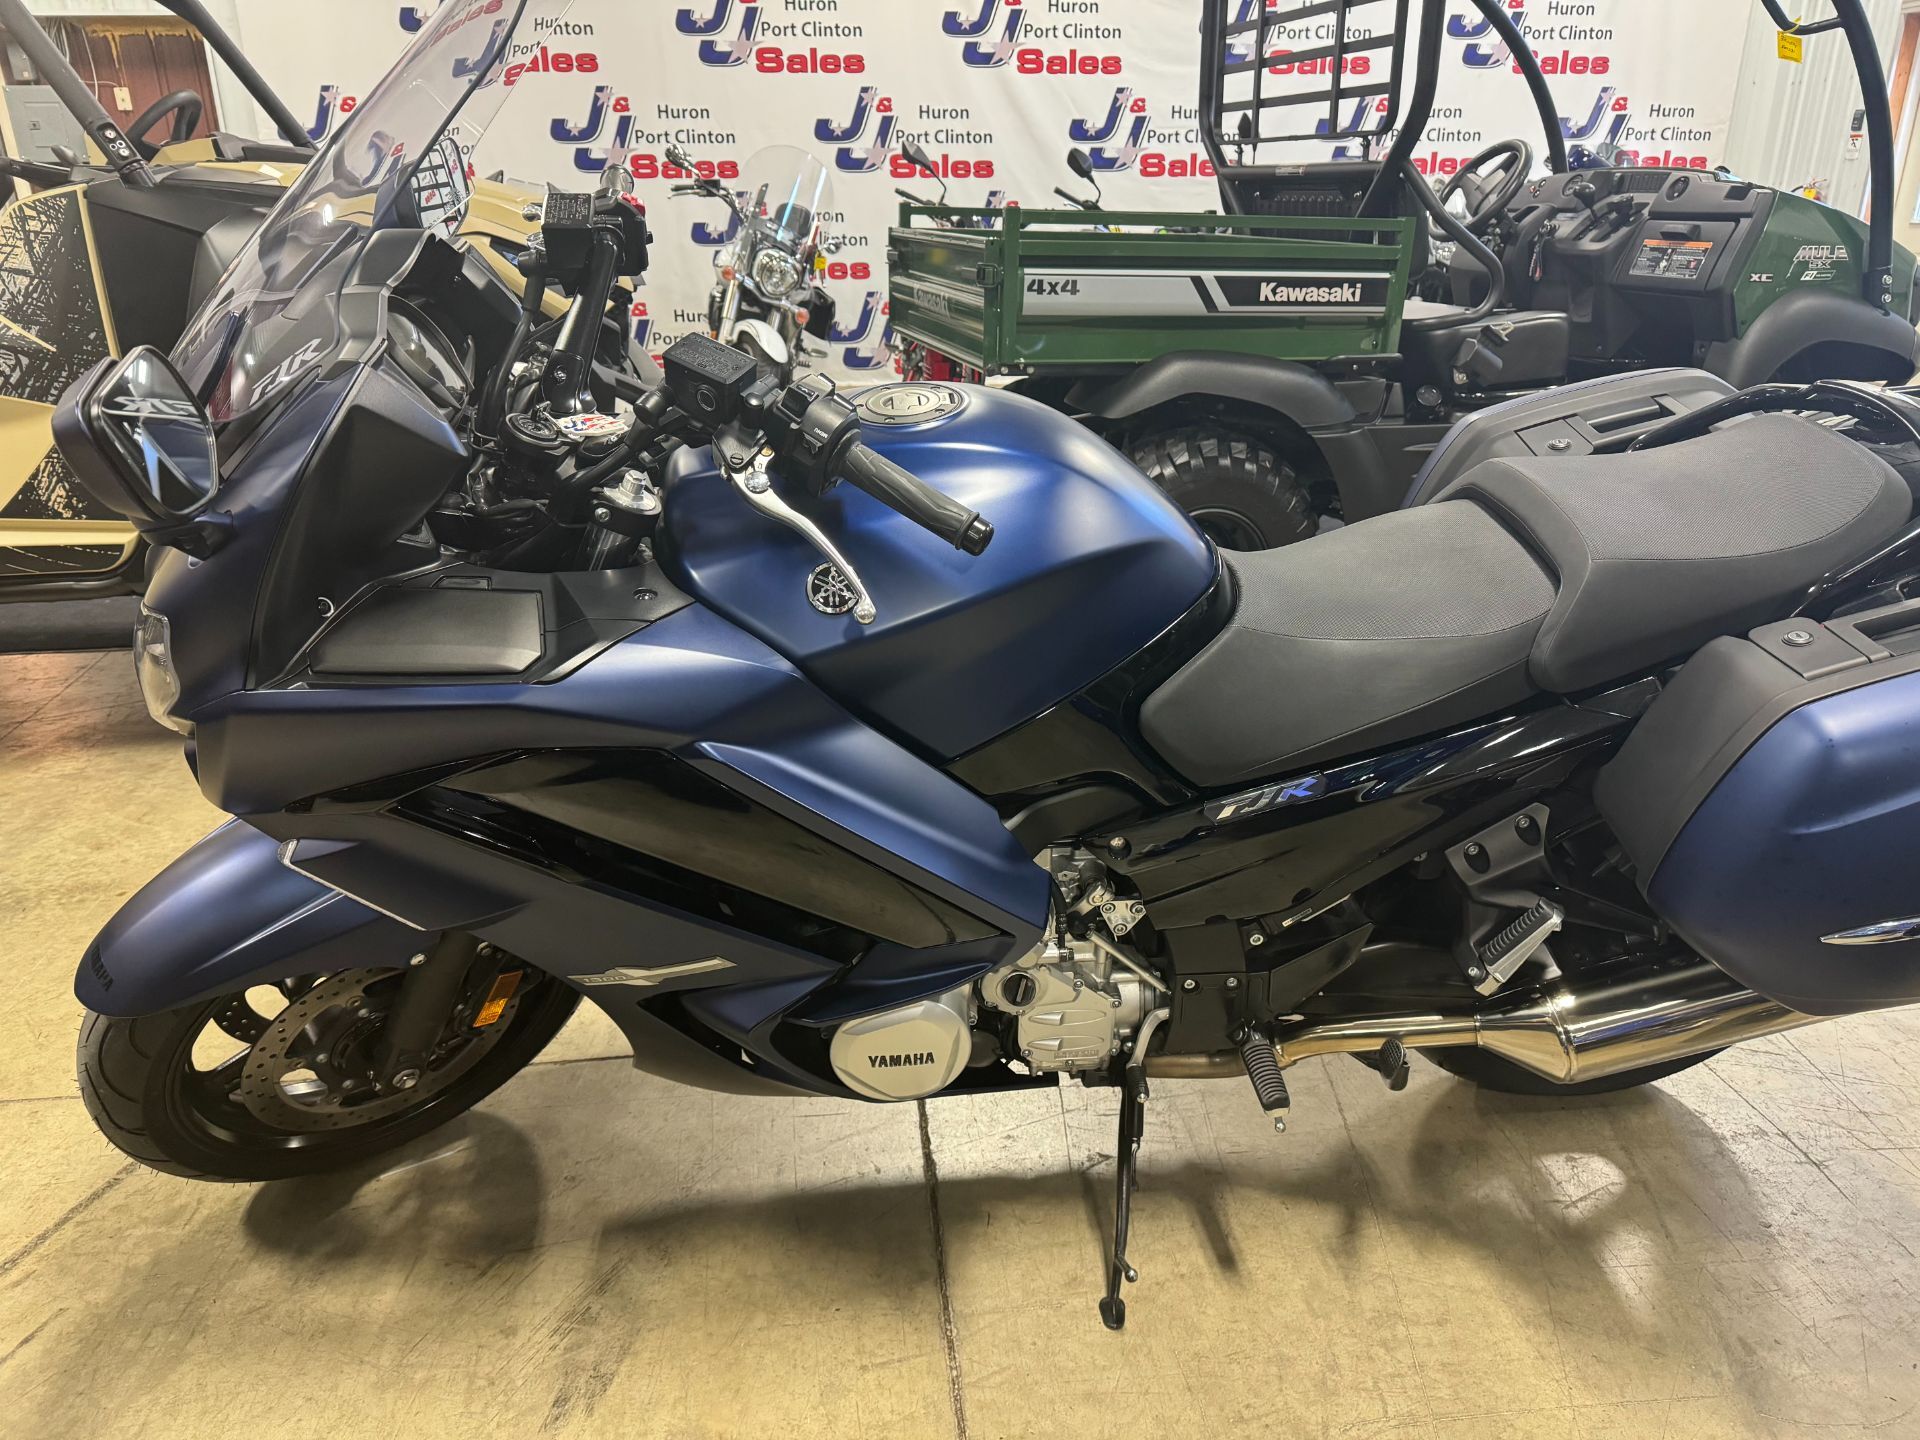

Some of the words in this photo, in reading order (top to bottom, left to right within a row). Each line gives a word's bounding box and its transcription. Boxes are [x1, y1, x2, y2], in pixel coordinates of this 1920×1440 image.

[784, 0, 838, 11] Huron
[1048, 0, 1099, 13] Huron
[1547, 1, 1595, 16] Huron
[761, 21, 797, 37] Port
[801, 21, 863, 37] Clinton
[1023, 23, 1061, 39] Port
[1062, 23, 1122, 39] Clinton
[1277, 25, 1310, 40] Port
[1523, 25, 1555, 40] Port
[1558, 25, 1613, 40] Clinton
[755, 47, 865, 74] Sales
[1016, 48, 1122, 75] Sales
[657, 104, 710, 119] Huron
[918, 104, 970, 120] Huron
[1649, 103, 1695, 118] Huron
[635, 129, 670, 144] Port
[675, 128, 736, 144] Clinton
[896, 129, 930, 144] Port
[934, 129, 993, 144] Clinton
[1148, 129, 1180, 144] Port
[1427, 128, 1482, 143] Clinton
[1625, 127, 1656, 142] Port
[1660, 126, 1712, 142] Clinton
[1793, 245, 1849, 261] MULE
[1808, 260, 1832, 270] SX
[1749, 273, 1774, 282] XC
[1027, 278, 1080, 296] 4x4
[1259, 281, 1362, 303] Kawasaki
[868, 1051, 935, 1069] YAMAHA
